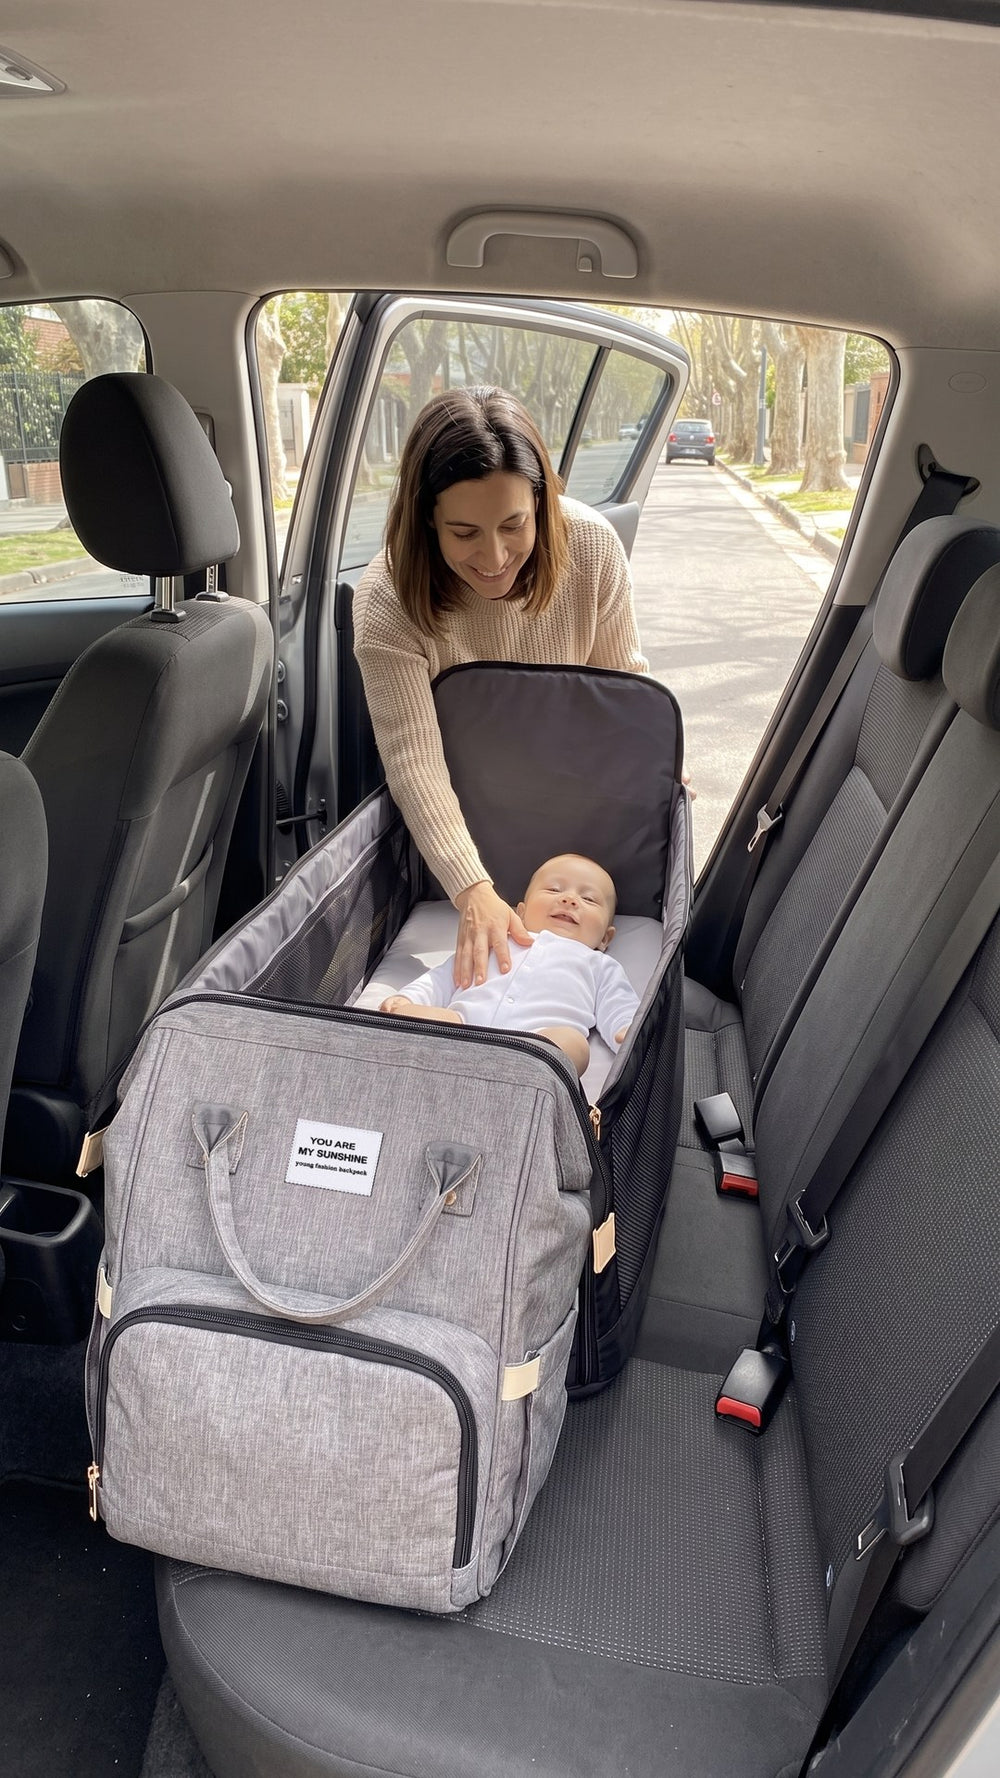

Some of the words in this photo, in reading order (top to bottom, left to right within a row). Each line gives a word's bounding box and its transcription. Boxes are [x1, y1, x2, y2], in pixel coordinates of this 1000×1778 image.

[310, 1137, 333, 1147] YOU
[334, 1141, 356, 1151] ARE
[298, 1147, 315, 1156] MY
[316, 1149, 368, 1164] SUNSHINE
[295, 1160, 314, 1169] young
[315, 1163, 338, 1172] fashion
